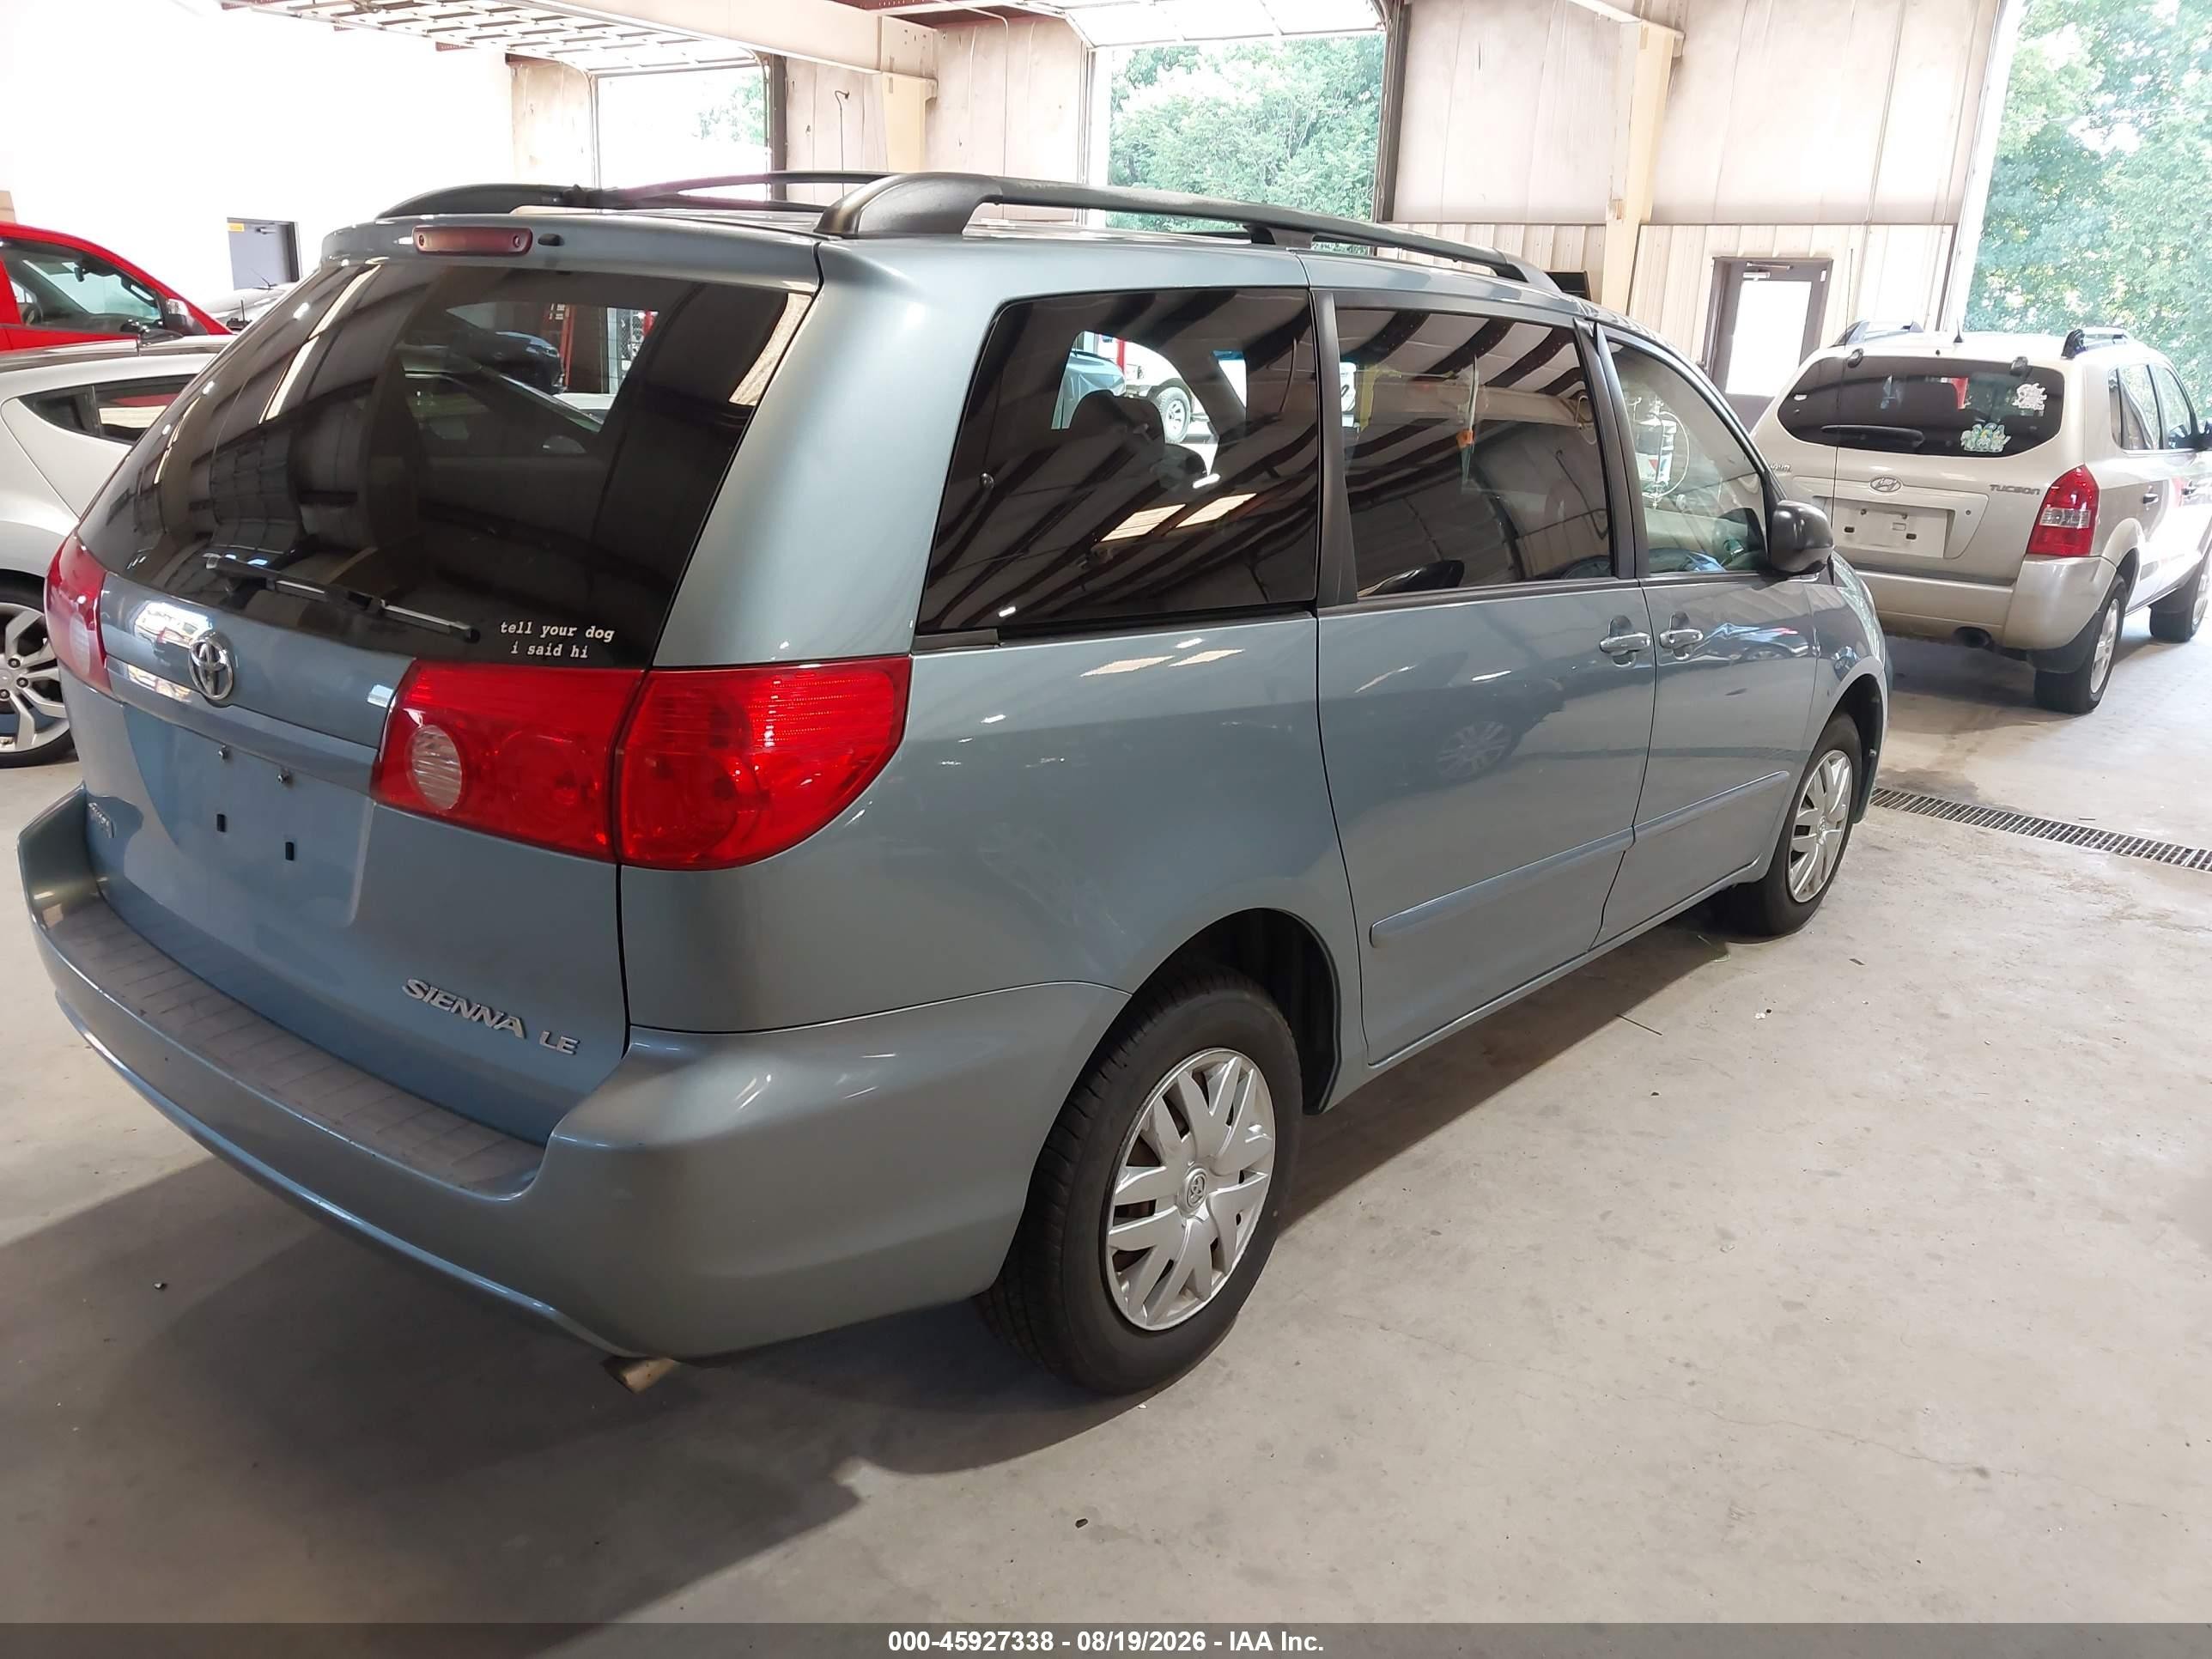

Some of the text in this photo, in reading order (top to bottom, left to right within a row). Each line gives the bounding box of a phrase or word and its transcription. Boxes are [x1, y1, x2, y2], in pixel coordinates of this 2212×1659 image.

[1990, 483, 2040, 495] TUCSON
[501, 621, 615, 643] tell your dog
[511, 640, 588, 659] i said hi
[401, 978, 580, 1055] SIENNA LE
